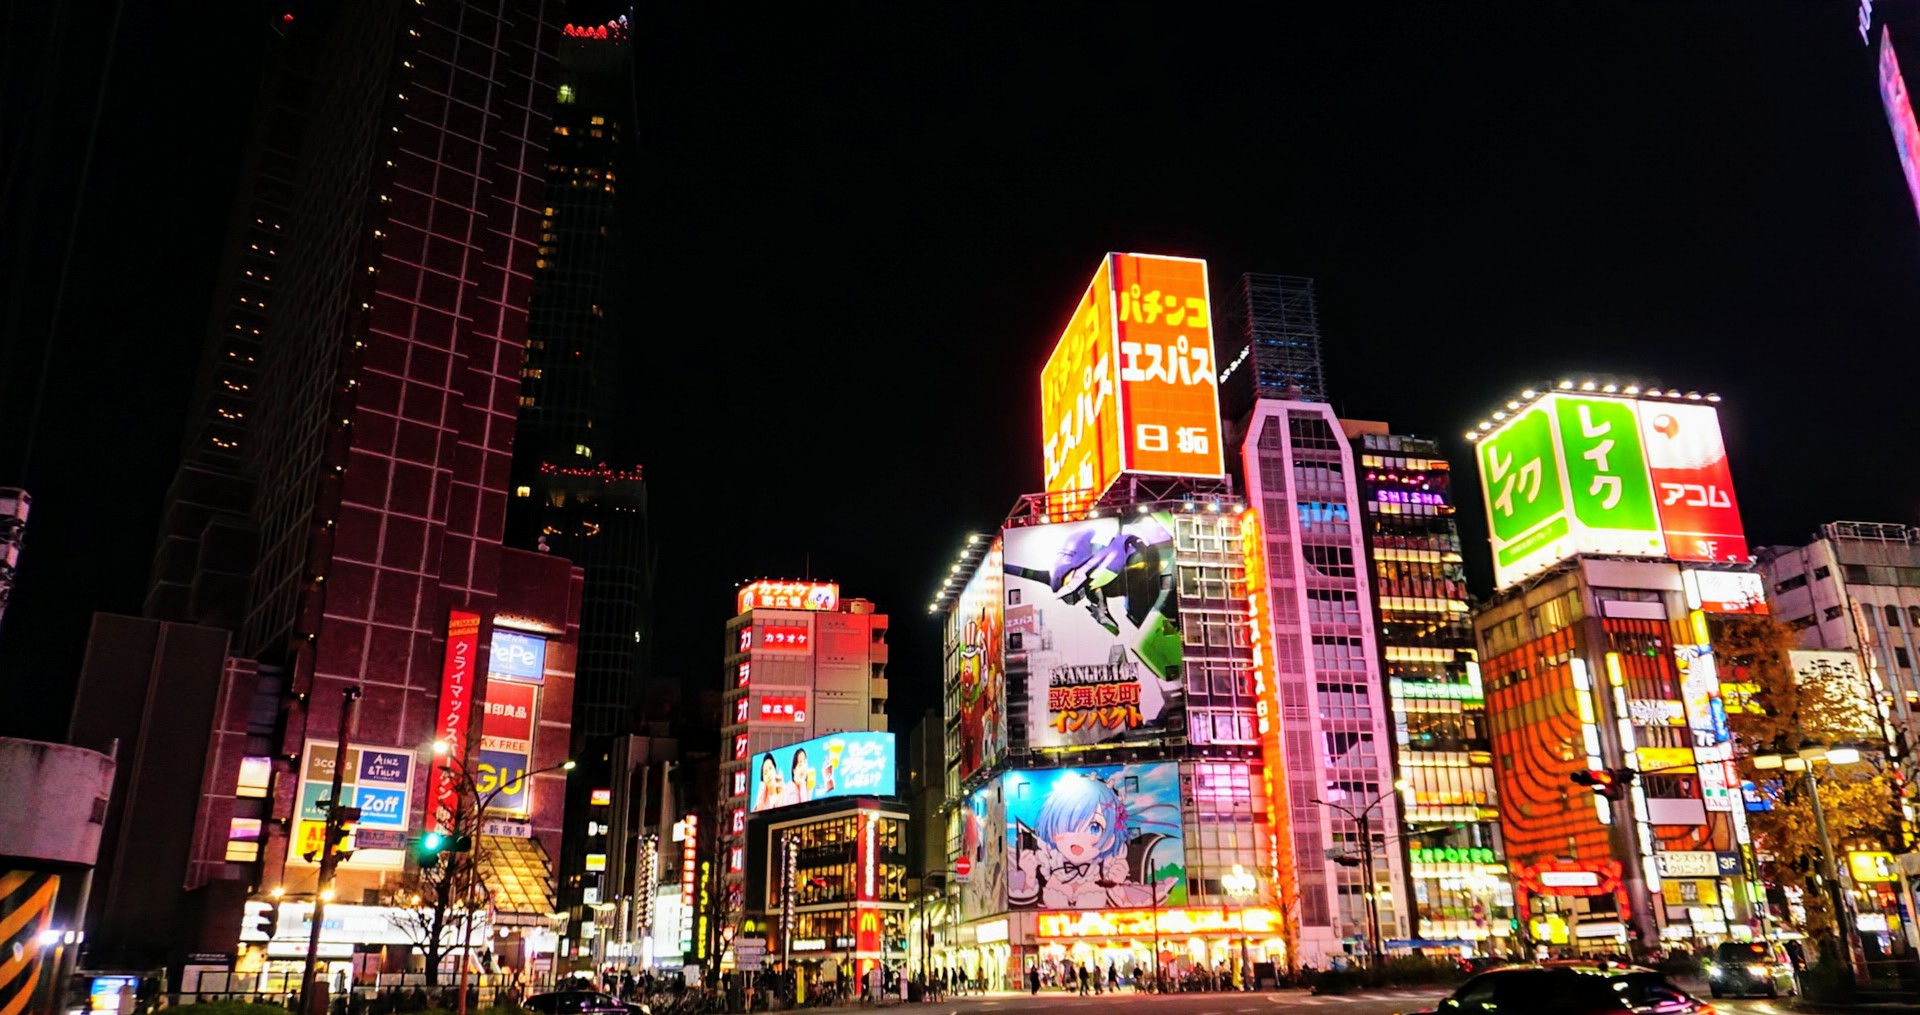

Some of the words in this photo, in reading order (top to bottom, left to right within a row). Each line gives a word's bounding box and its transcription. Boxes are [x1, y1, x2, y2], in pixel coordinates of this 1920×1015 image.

[1119, 284, 1208, 328] パチンコ
[1120, 335, 1215, 386] エスパス
[1044, 352, 1113, 483] エスパス
[1136, 423, 1209, 455] 日拓
[1577, 405, 1622, 509] レイク
[1489, 446, 1542, 517] レイク
[1660, 482, 1732, 508] アコム
[1378, 490, 1444, 505] SHISHA
[1696, 540, 1718, 558] 3F
[758, 581, 809, 596] カラオケ
[765, 633, 807, 643] カラオケ
[1049, 683, 1141, 711] 歌舞伎町
[1048, 705, 1143, 734] インパクト
[500, 740, 526, 751] FREE
[313, 758, 352, 770] 3COS
[476, 763, 524, 796] GU
[361, 794, 400, 813] Zoff
[1719, 857, 1737, 870] 3F
